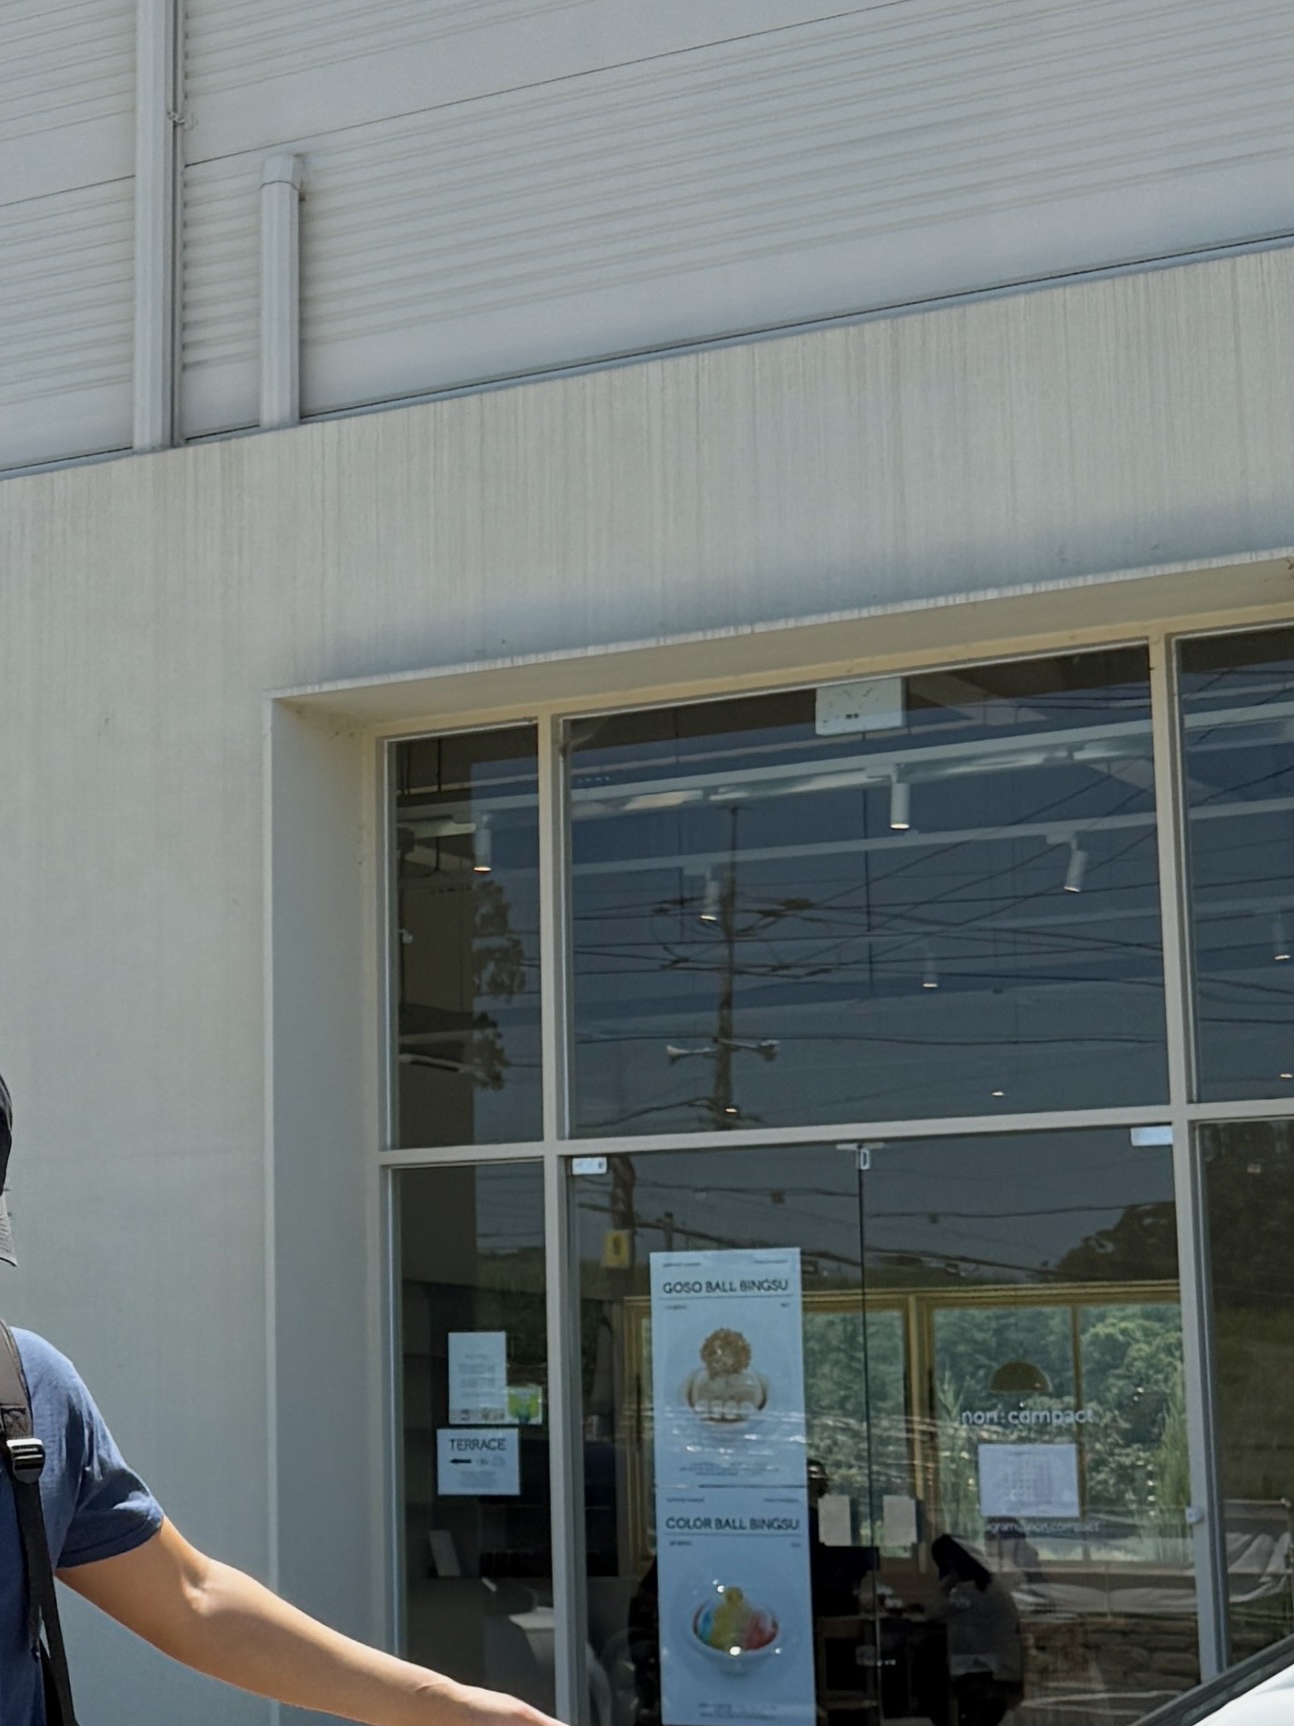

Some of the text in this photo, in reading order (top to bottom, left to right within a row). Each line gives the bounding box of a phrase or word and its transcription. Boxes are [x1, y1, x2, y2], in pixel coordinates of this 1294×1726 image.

[662, 1278, 789, 1295] GOSO BALL BINGSU
[449, 1437, 508, 1452] TERRACE
[665, 1516, 801, 1531] COLOR BALL BINGSU
